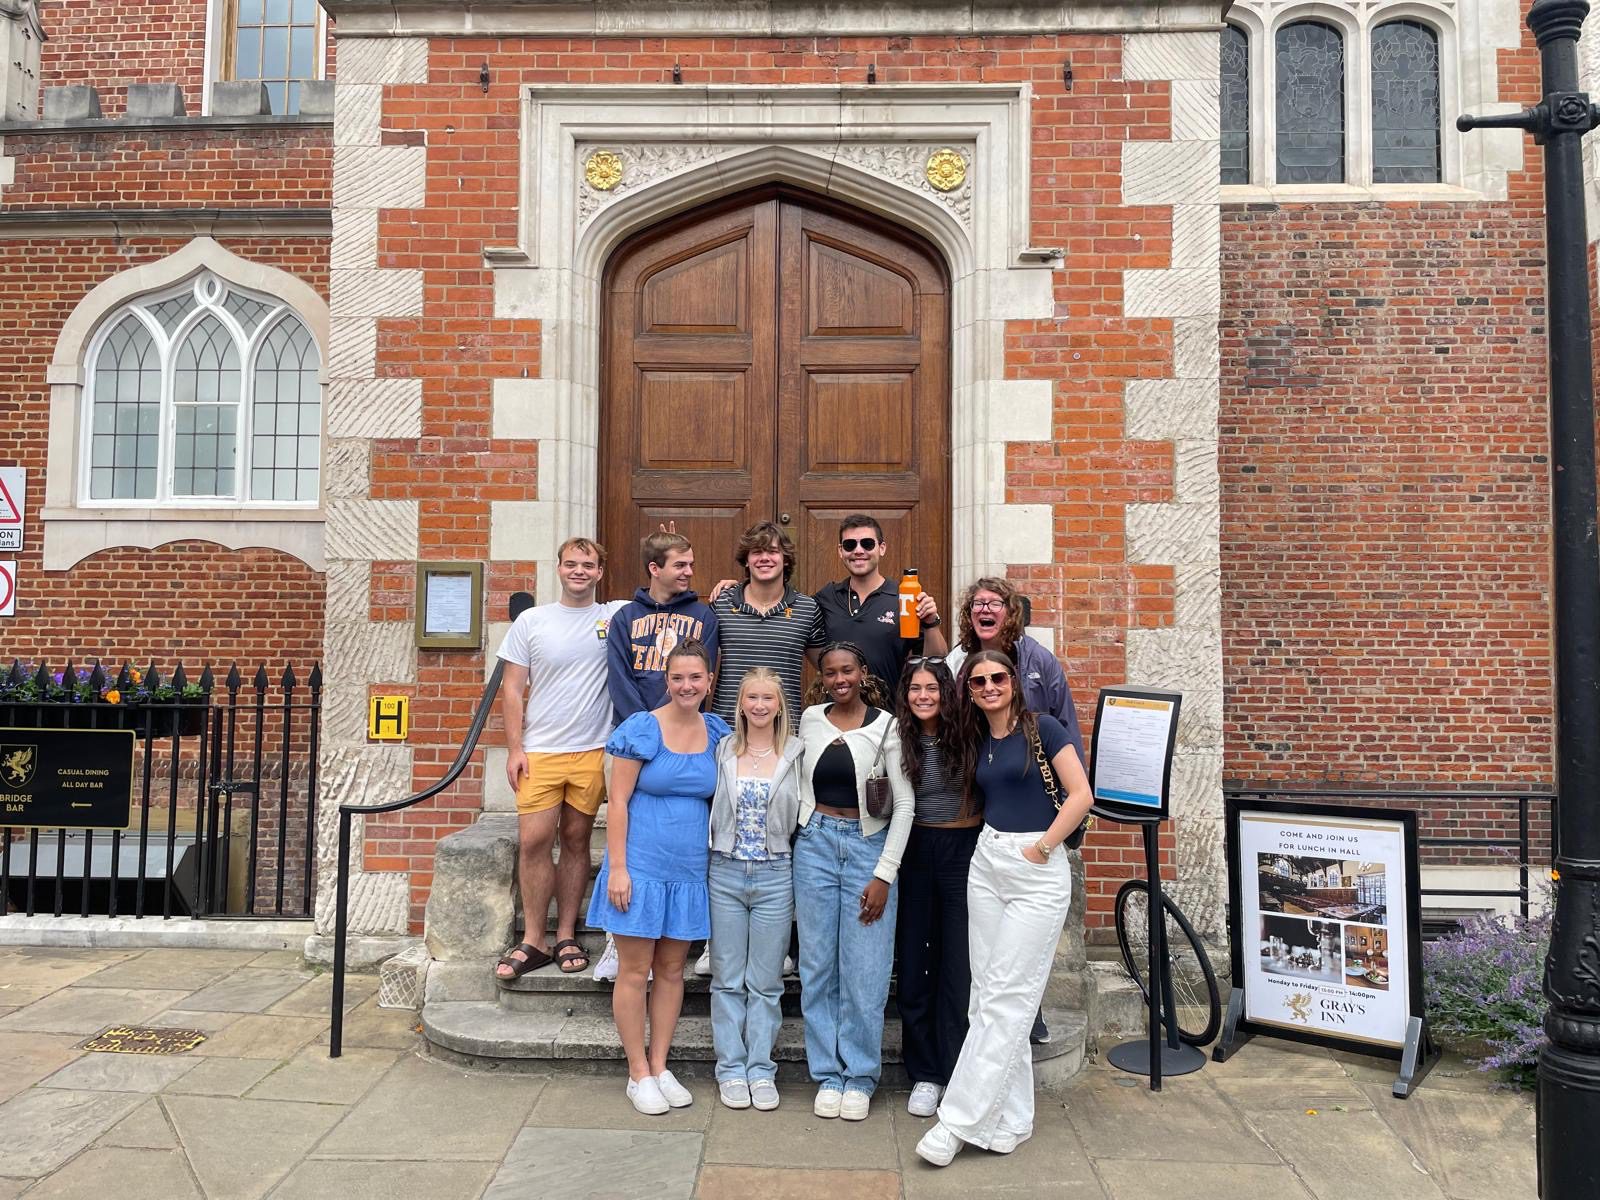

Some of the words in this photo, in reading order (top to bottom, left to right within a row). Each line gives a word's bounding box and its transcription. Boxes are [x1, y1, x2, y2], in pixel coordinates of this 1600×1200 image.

[899, 594, 914, 616] T
[384, 702, 395, 710] 100
[375, 701, 403, 734] H
[57, 768, 84, 776] CASUAL
[0, 794, 33, 803] BRIDGE
[6, 803, 24, 812] BAR
[1280, 830, 1303, 838] COME
[1306, 832, 1323, 840] AND
[1279, 842, 1295, 850] FOR
[1297, 844, 1325, 853] LUNCH
[1340, 848, 1360, 856] HALL
[1267, 978, 1291, 987] Monday
[1299, 983, 1319, 991] Friday
[1349, 990, 1376, 999] 14:00pm
[1320, 999, 1366, 1015] GRAY'S
[1321, 1011, 1345, 1024] INN
